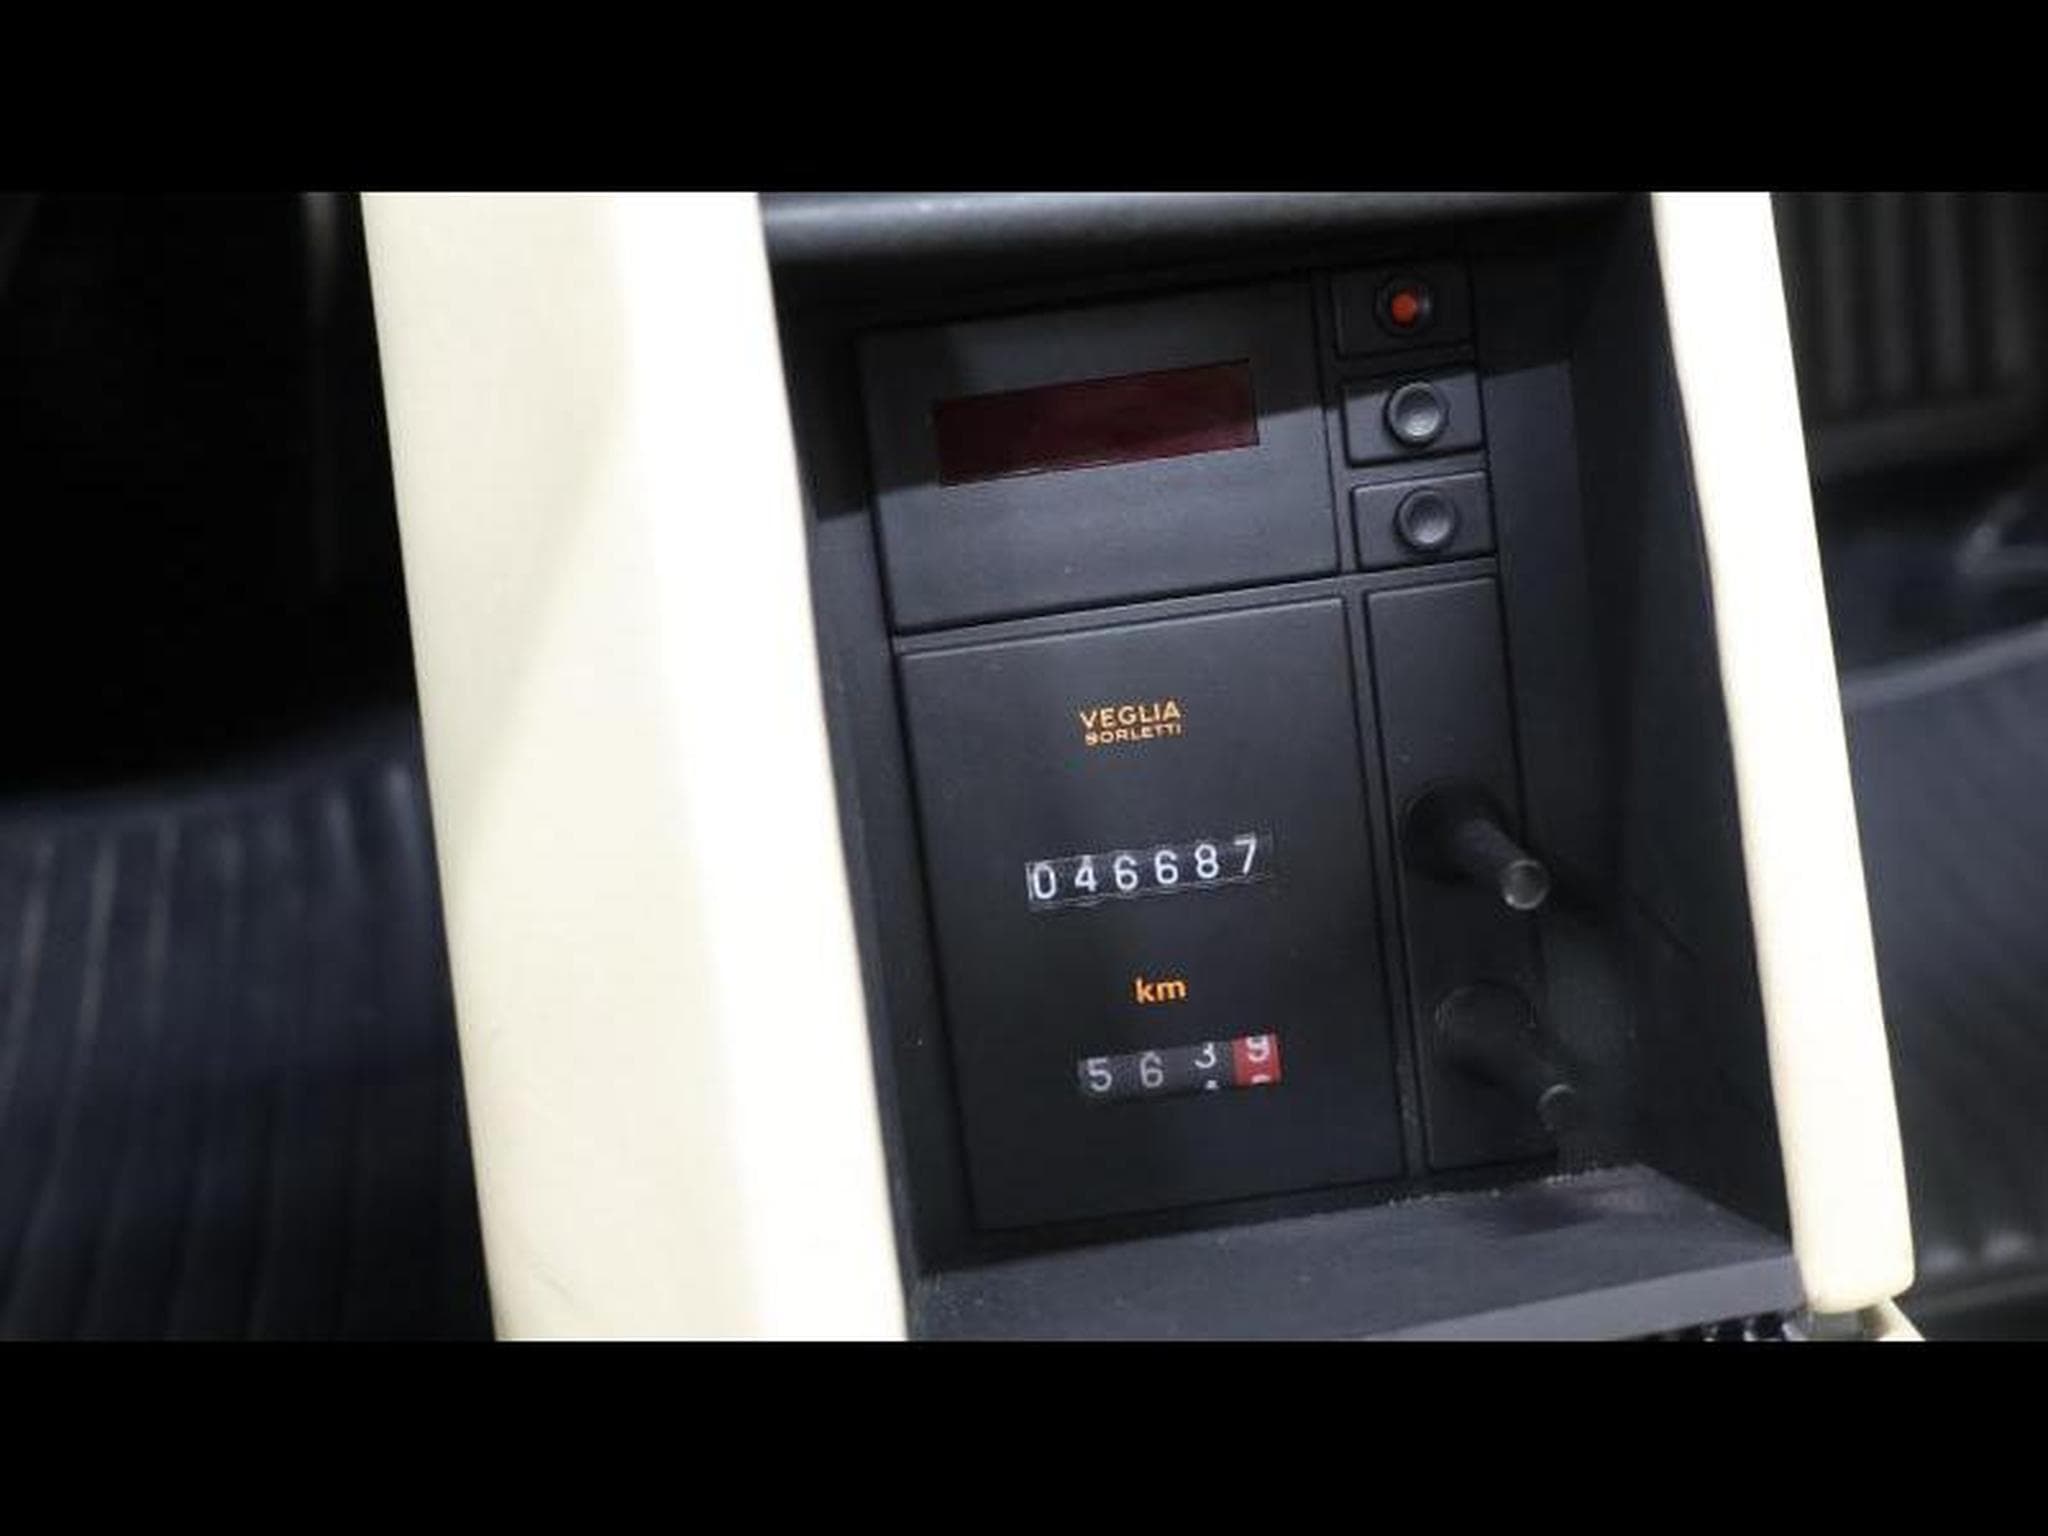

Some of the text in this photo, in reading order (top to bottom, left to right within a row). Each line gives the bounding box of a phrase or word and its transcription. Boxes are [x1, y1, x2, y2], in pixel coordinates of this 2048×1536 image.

[1079, 700, 1182, 729] VEGLIA
[1084, 723, 1183, 746] BORLETTI
[1032, 833, 1257, 899] 046687
[1135, 976, 1187, 1004] km
